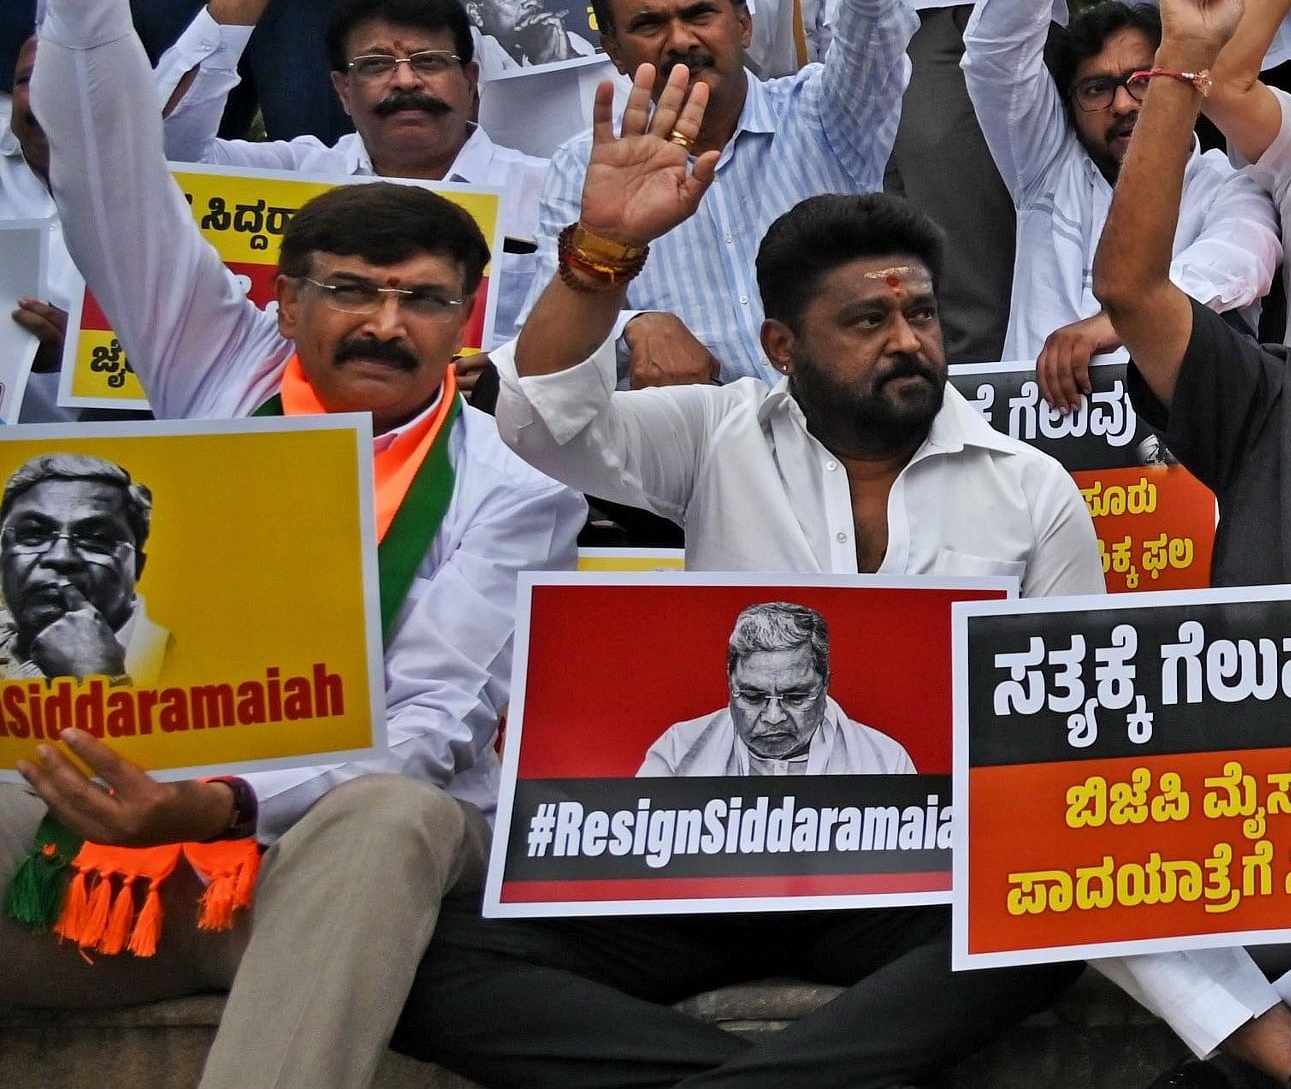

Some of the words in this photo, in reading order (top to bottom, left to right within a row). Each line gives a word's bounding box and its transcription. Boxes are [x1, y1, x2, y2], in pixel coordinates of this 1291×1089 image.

[1142, 533, 1194, 580] ಫಲ
[993, 624, 1154, 748] ಸತ್ಯಕ್ಕೆ
[527, 795, 953, 868] #ResignSiddaramaia
[1066, 766, 1191, 829] ಬಿಜೆಪಿ
[1007, 840, 1275, 916] ಪಾದಯಾತ್ರೆಗೆ
